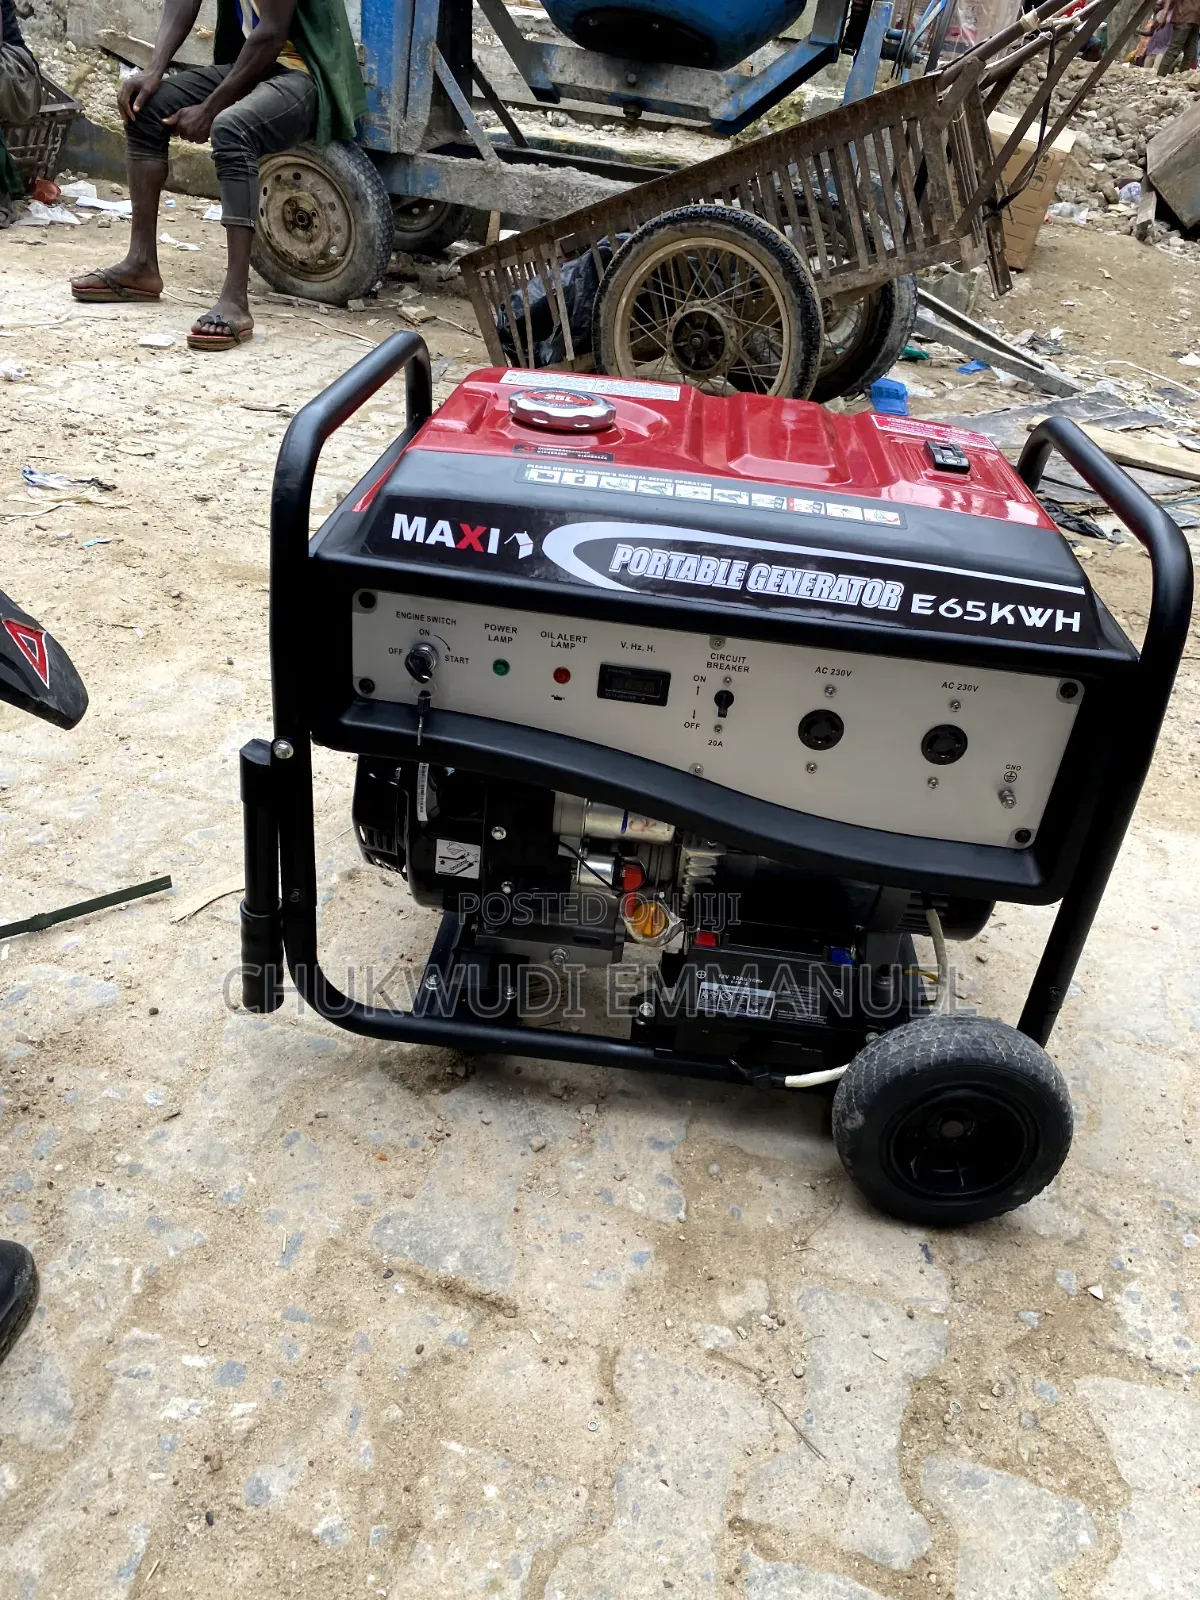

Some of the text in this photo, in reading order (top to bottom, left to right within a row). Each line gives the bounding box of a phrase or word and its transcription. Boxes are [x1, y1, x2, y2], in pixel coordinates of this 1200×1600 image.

[526, 463, 552, 471] PLEASE
[552, 465, 575, 473] REFER
[618, 473, 647, 481] MANUAL
[648, 475, 674, 483] BEFORE
[674, 478, 712, 488] OPERATION
[391, 513, 500, 555] MAXI
[609, 543, 1081, 632] PORTABLE GENERATOR E65KWH
[396, 611, 457, 626] ENGINE SWITCH
[419, 628, 430, 637] ON
[484, 623, 518, 634] POWER
[488, 634, 513, 644] LAMP
[540, 631, 588, 644] OIL ALERT
[550, 640, 576, 650] LAMP
[388, 647, 403, 655] OFF
[444, 655, 469, 665] START
[710, 652, 747, 664] CIRCUIT
[706, 661, 750, 673] BREAKER
[814, 666, 853, 677] AC 230V
[693, 674, 707, 683] ON
[941, 681, 979, 693] AC 230V
[683, 721, 701, 730] OFF
[708, 739, 723, 748] 20A
[1005, 763, 1022, 772] GND
